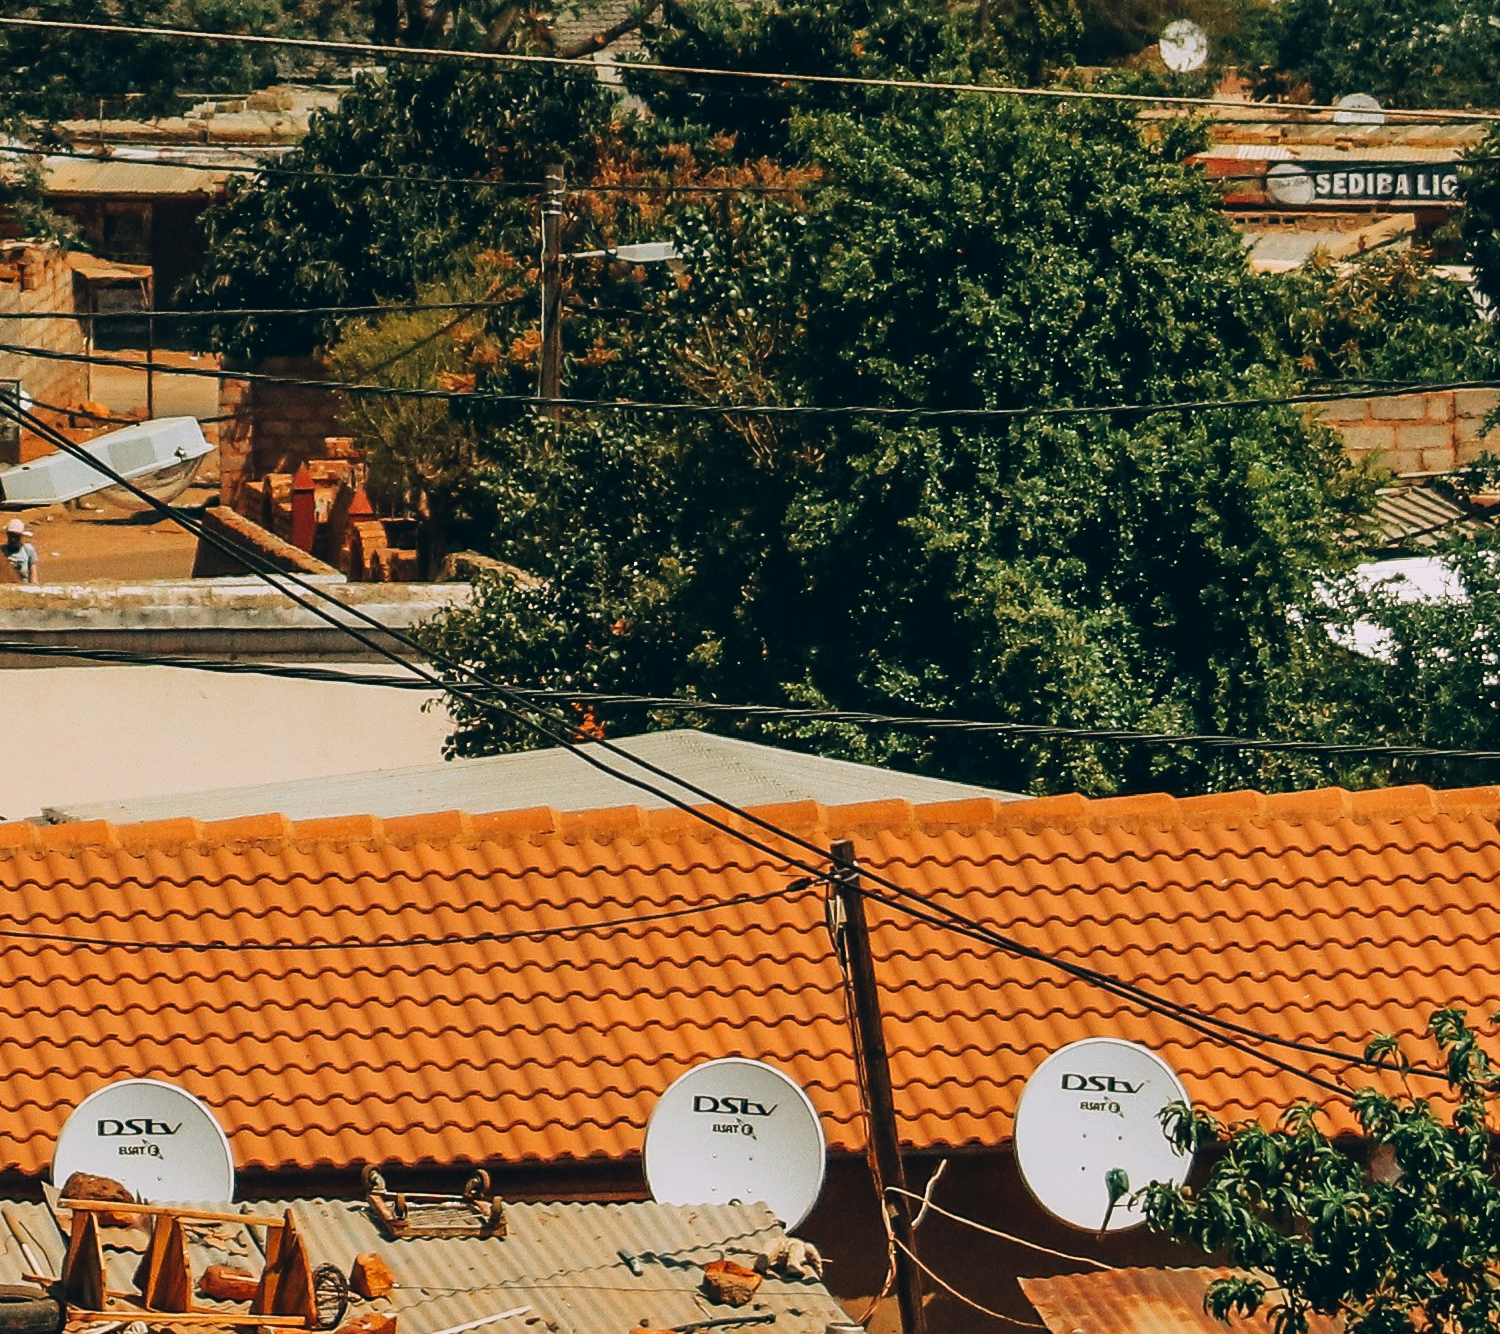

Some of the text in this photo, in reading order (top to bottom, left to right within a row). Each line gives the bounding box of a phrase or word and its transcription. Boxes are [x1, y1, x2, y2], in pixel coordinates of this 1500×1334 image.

[1316, 172, 1410, 196] SEDIBA
[1061, 1073, 1145, 1094] DStv
[693, 1095, 778, 1116] DStv
[97, 1118, 183, 1137] DStv
